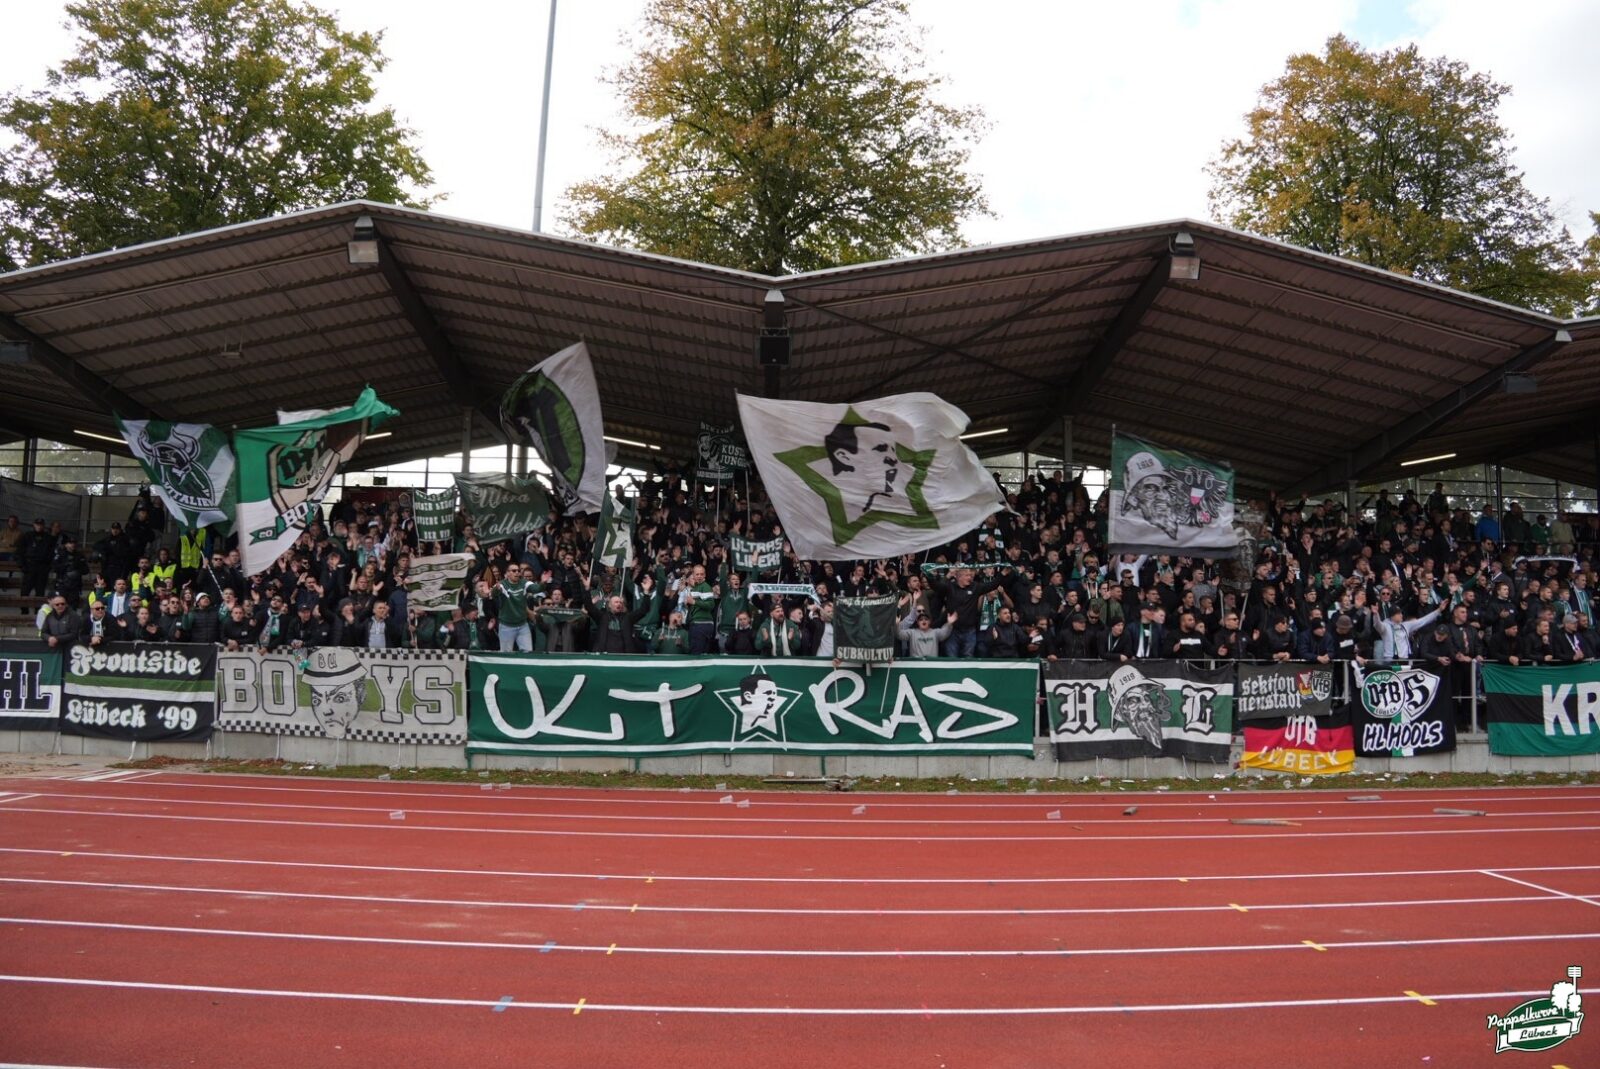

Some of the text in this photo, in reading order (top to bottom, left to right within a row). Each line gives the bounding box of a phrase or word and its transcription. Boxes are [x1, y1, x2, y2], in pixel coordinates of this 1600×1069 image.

[720, 455, 747, 468] JUNG
[731, 537, 784, 553] ULTRAS
[1119, 672, 1136, 686] 1919
[1241, 672, 1296, 696] sektion
[1312, 678, 1330, 693] VfB
[1373, 674, 1391, 682] 1919
[1238, 690, 1303, 712] neustadt
[1541, 682, 1600, 736] KR
[65, 699, 147, 729] Lübeck
[1387, 720, 1443, 751] HOOLS
[1258, 746, 1340, 770] LÜBECK
